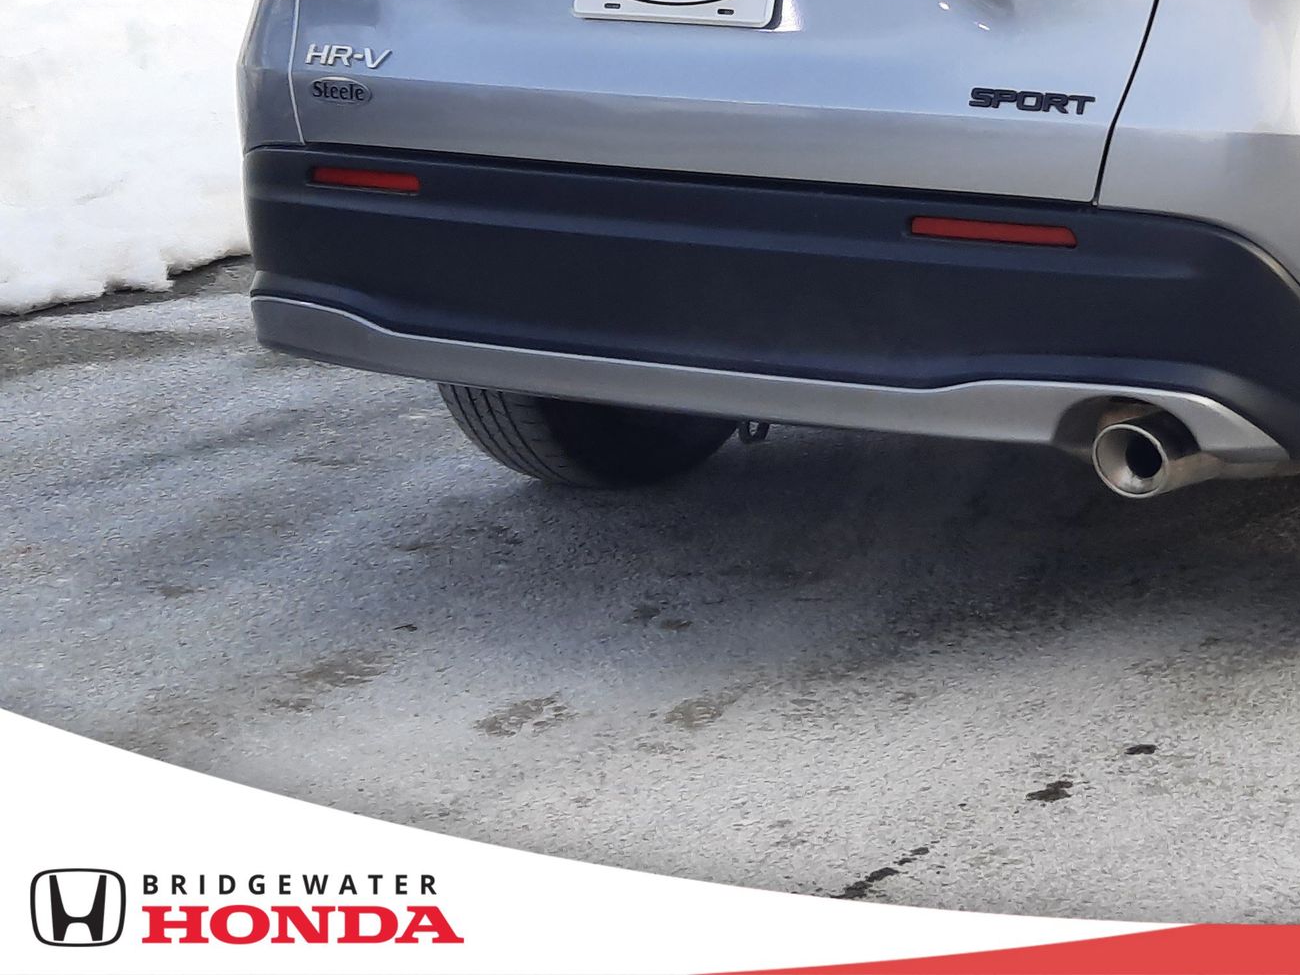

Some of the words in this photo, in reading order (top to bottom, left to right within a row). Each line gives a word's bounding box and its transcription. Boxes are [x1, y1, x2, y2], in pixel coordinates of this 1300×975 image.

[305, 43, 392, 69] HR-V
[311, 81, 365, 101] Steele
[968, 87, 1096, 115] SPORT
